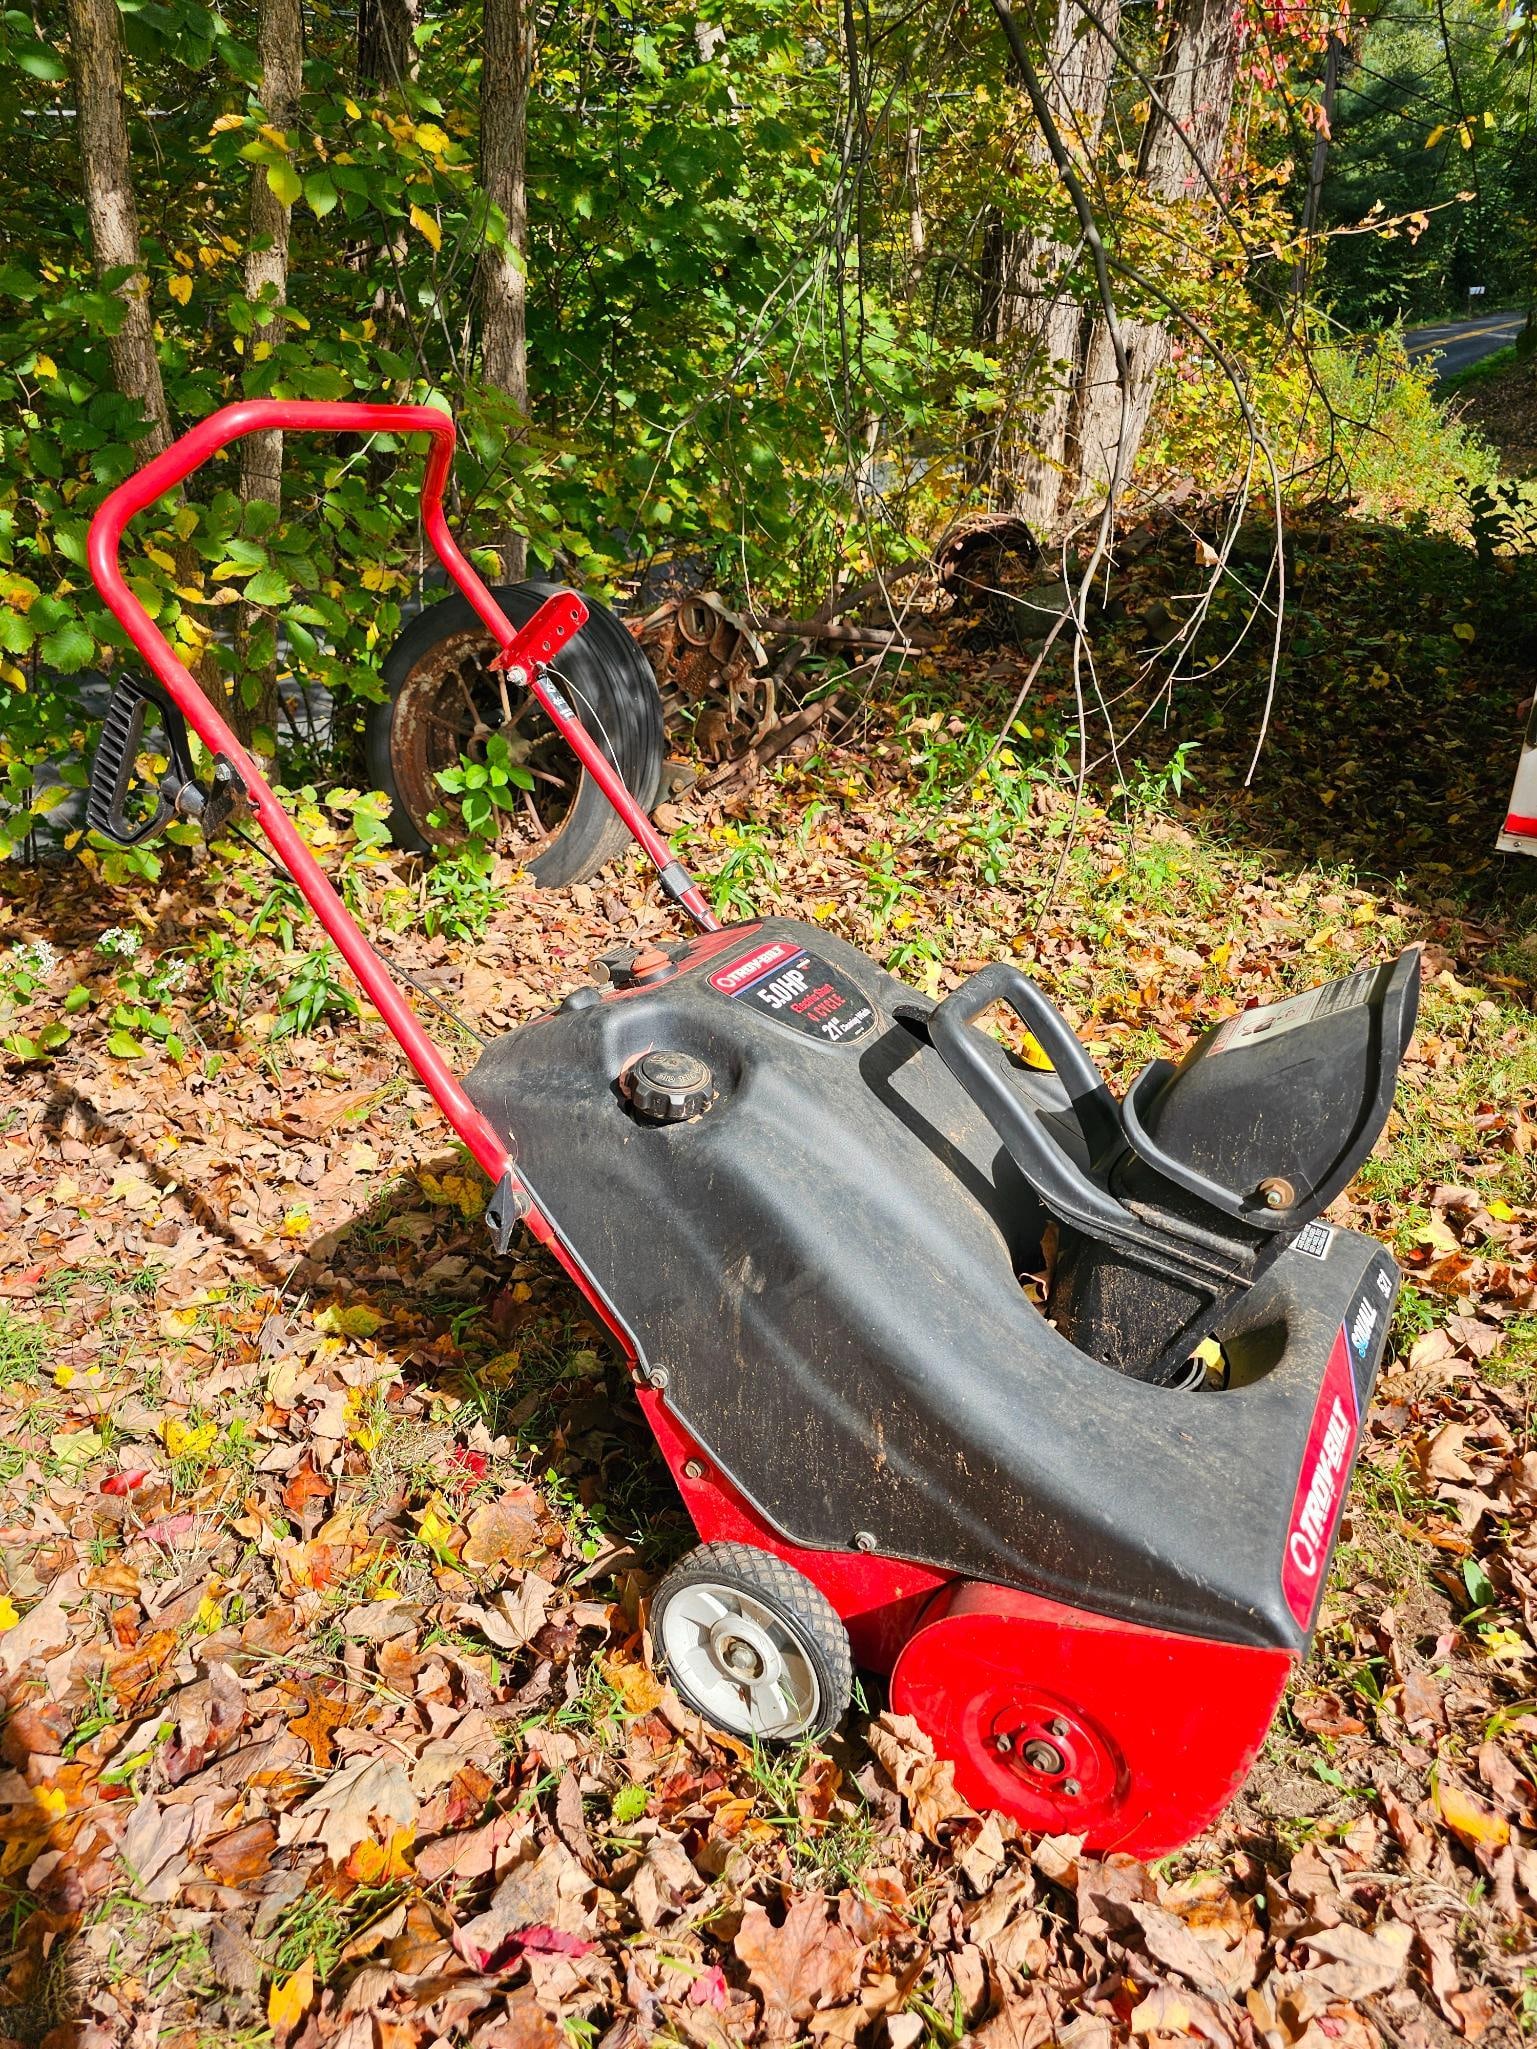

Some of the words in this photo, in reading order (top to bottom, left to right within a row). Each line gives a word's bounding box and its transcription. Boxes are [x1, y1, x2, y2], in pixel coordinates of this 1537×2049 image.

[728, 945, 786, 984] TROY-BILT
[756, 969, 809, 1009] 5.0HP
[813, 993, 846, 1018] CYCLE
[1299, 1396, 1352, 1549] TROY-BILT
